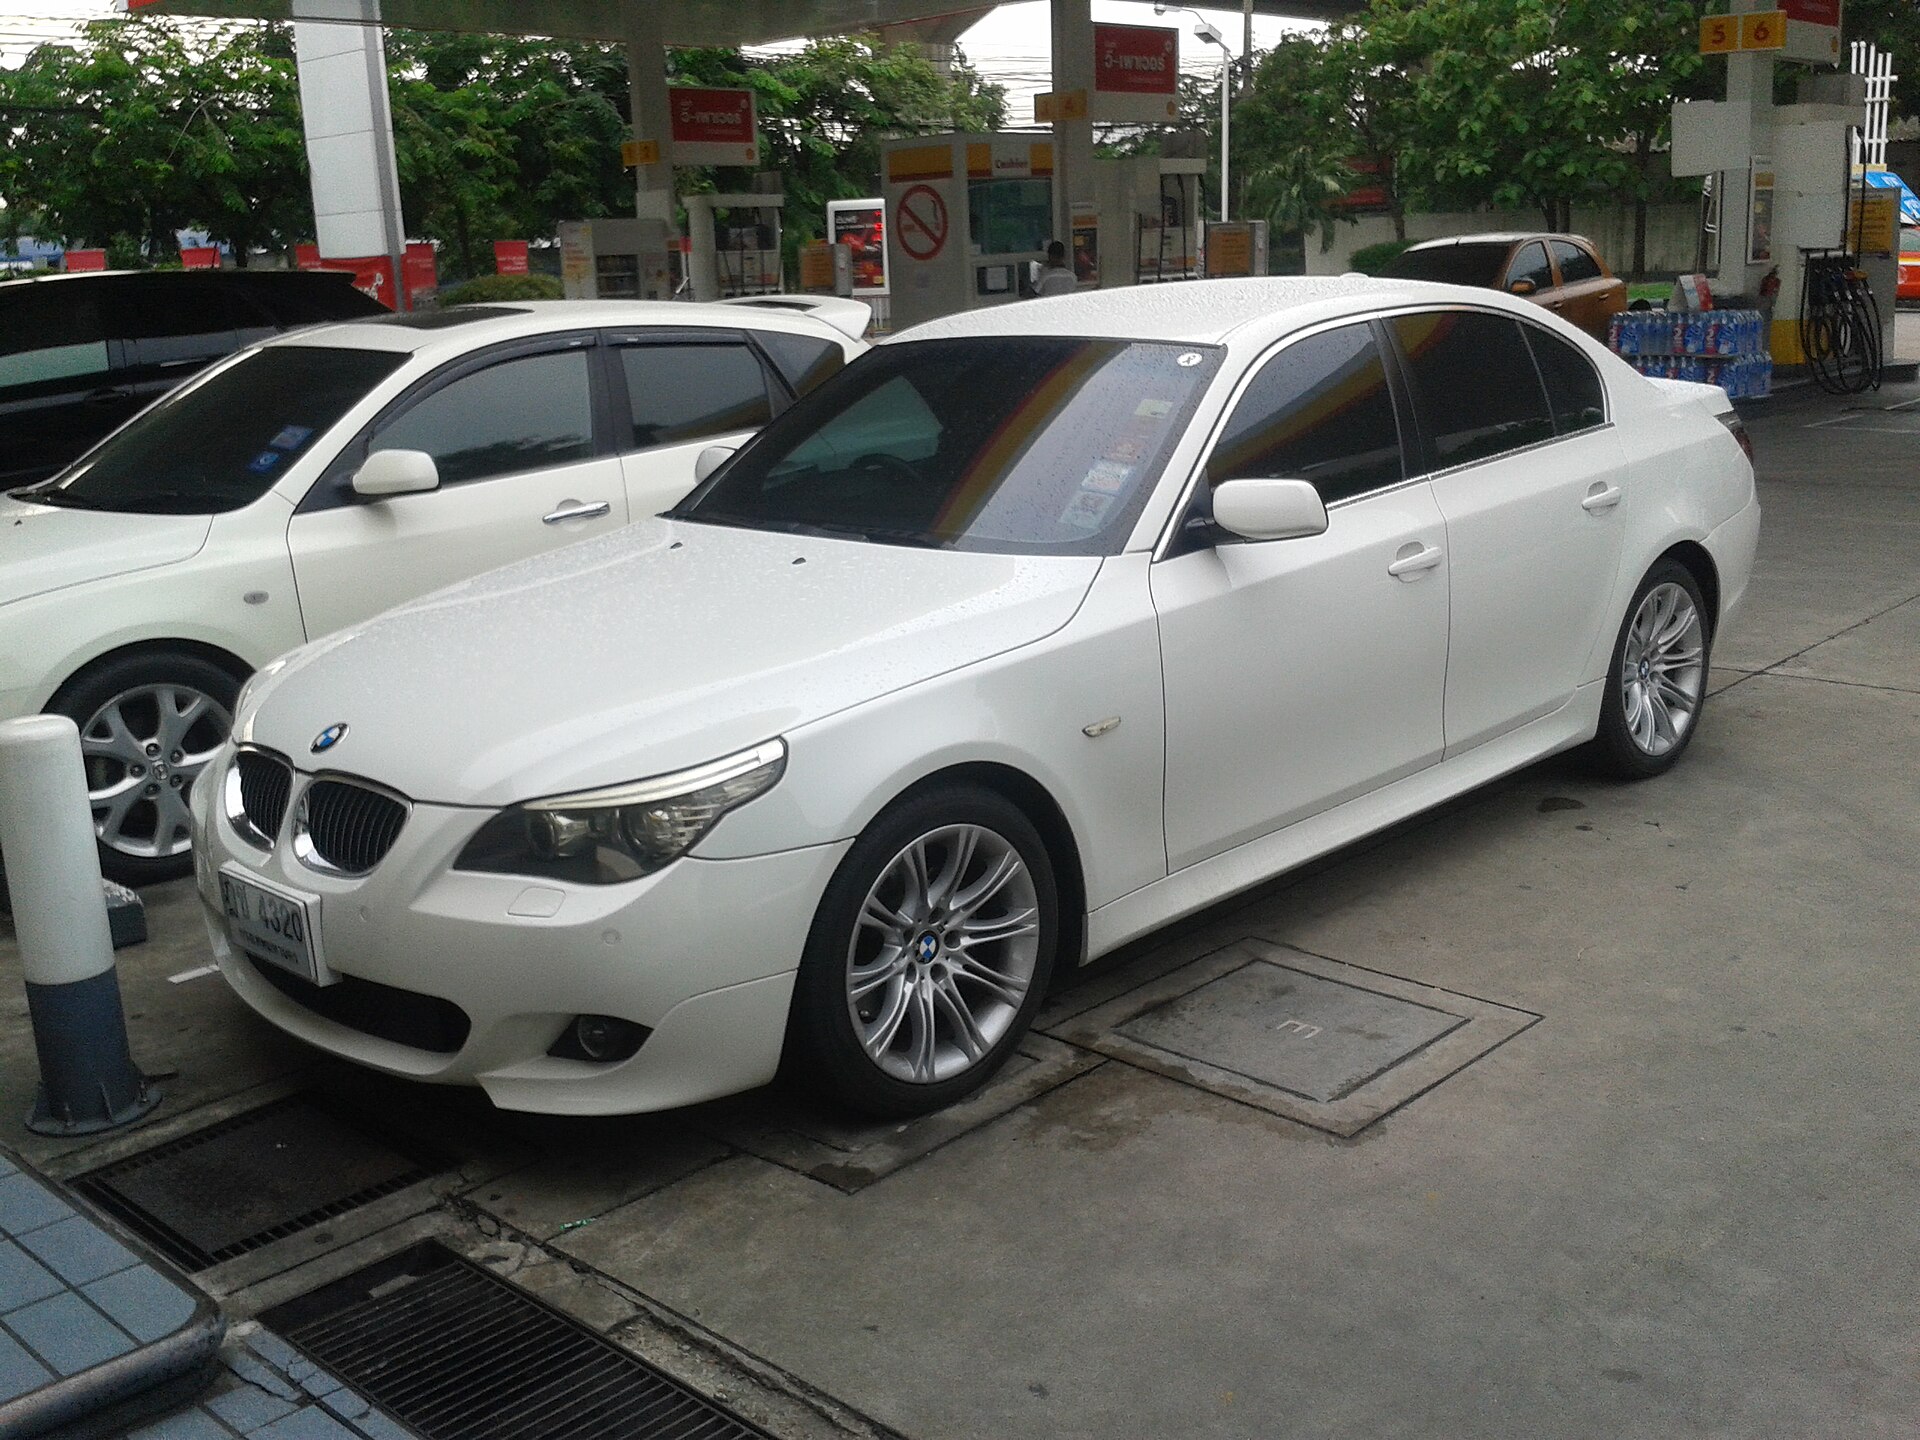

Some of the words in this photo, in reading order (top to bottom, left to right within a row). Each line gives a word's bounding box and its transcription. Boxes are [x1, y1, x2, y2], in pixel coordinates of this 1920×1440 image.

[1710, 23, 1727, 46] 5
[1753, 20, 1770, 42] 6
[1674, 327, 1682, 338] 2
[258, 894, 304, 942] 4320
